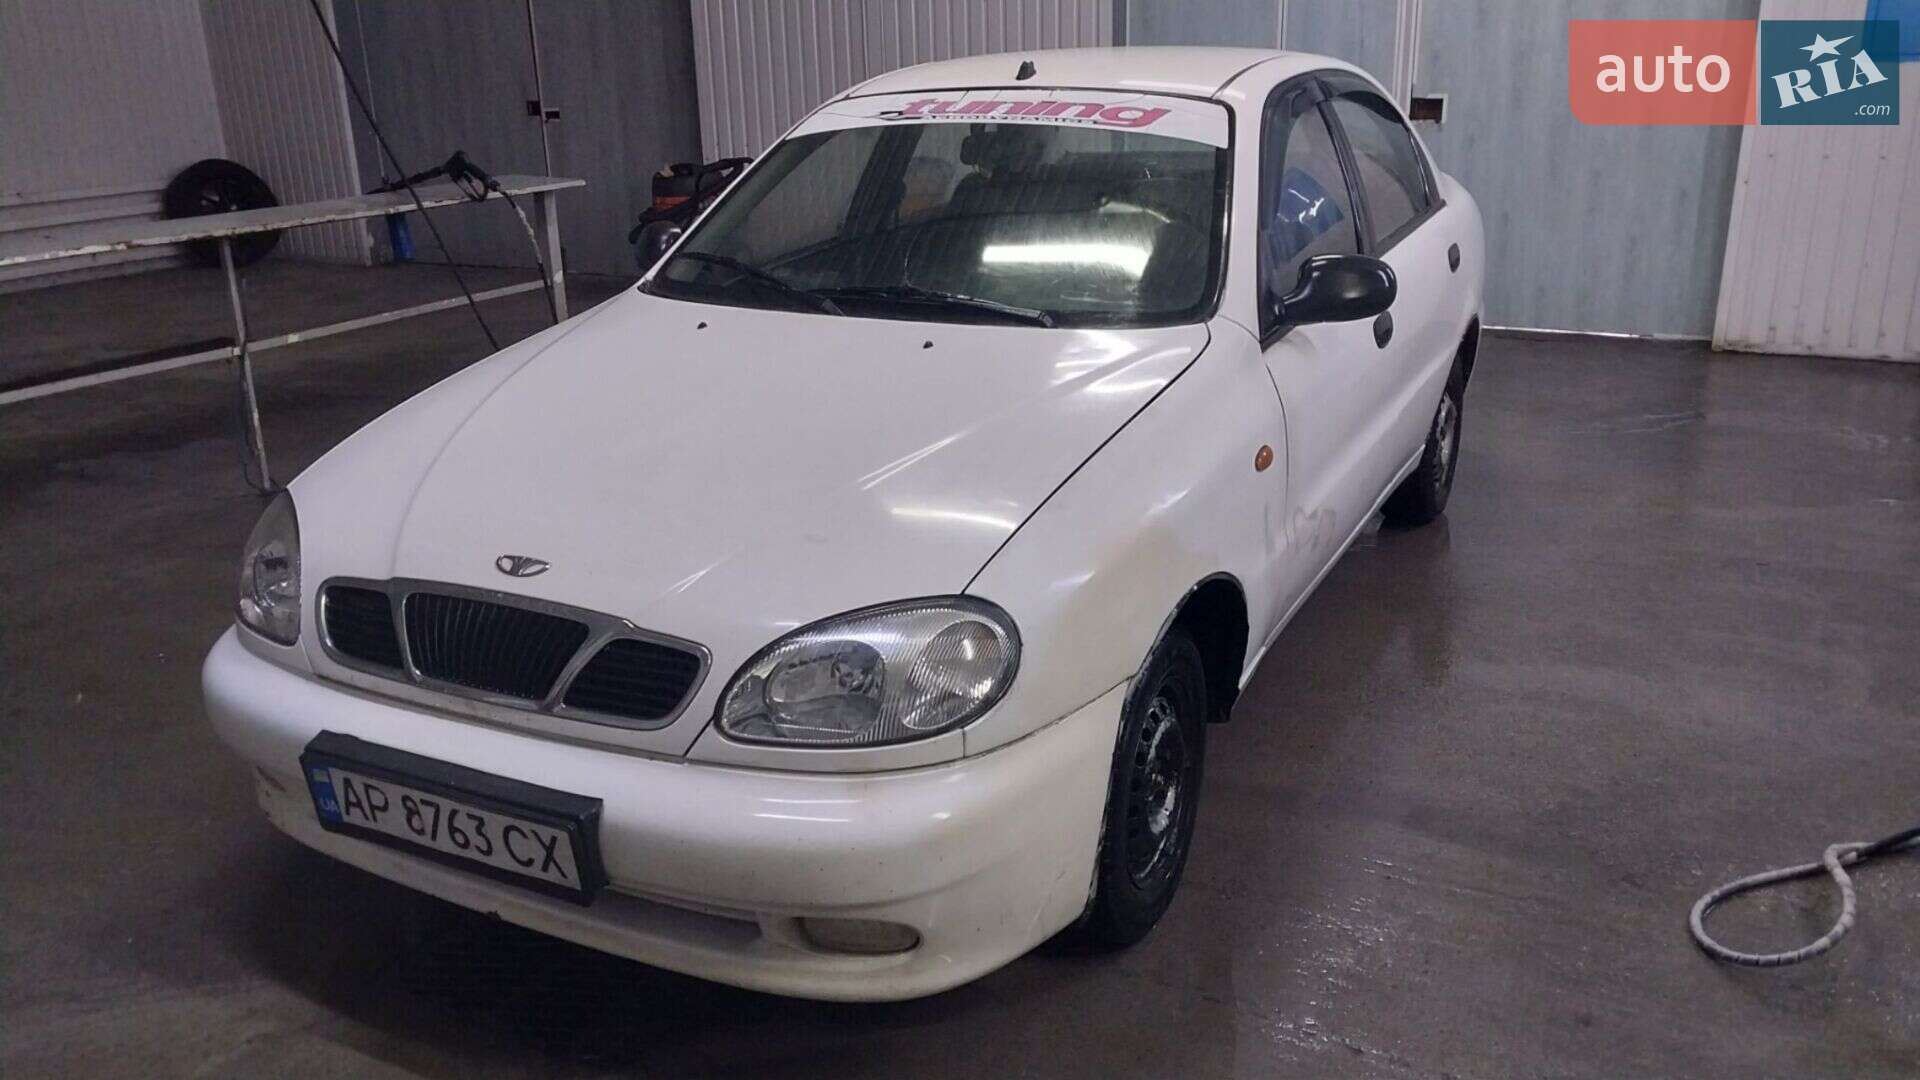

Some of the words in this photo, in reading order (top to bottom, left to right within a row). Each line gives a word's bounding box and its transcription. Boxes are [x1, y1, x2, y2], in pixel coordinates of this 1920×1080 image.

[900, 98, 1170, 128] tuning
[342, 777, 389, 823] AP
[401, 795, 492, 857] 8763
[502, 825, 568, 879] CX
